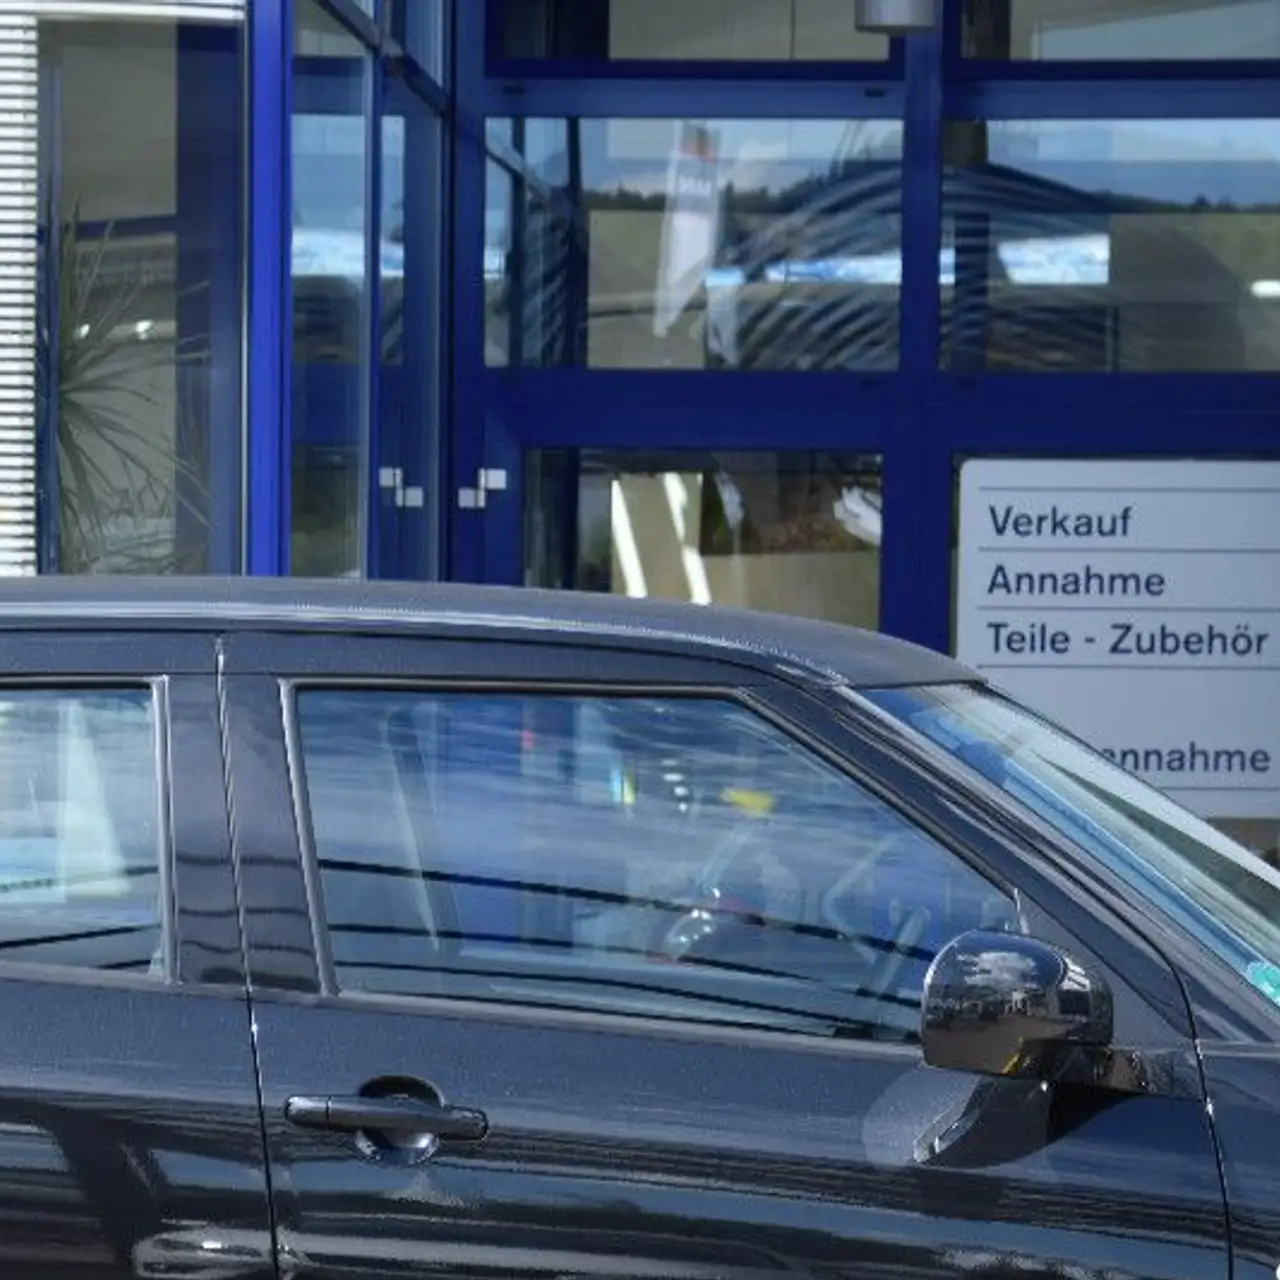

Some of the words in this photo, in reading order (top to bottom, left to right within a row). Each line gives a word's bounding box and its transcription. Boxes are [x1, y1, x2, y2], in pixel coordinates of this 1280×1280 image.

[989, 505, 1133, 537] Verkauf
[987, 564, 1166, 597] Annahme
[987, 623, 1071, 655] Teile
[1109, 624, 1269, 656] Zubehör
